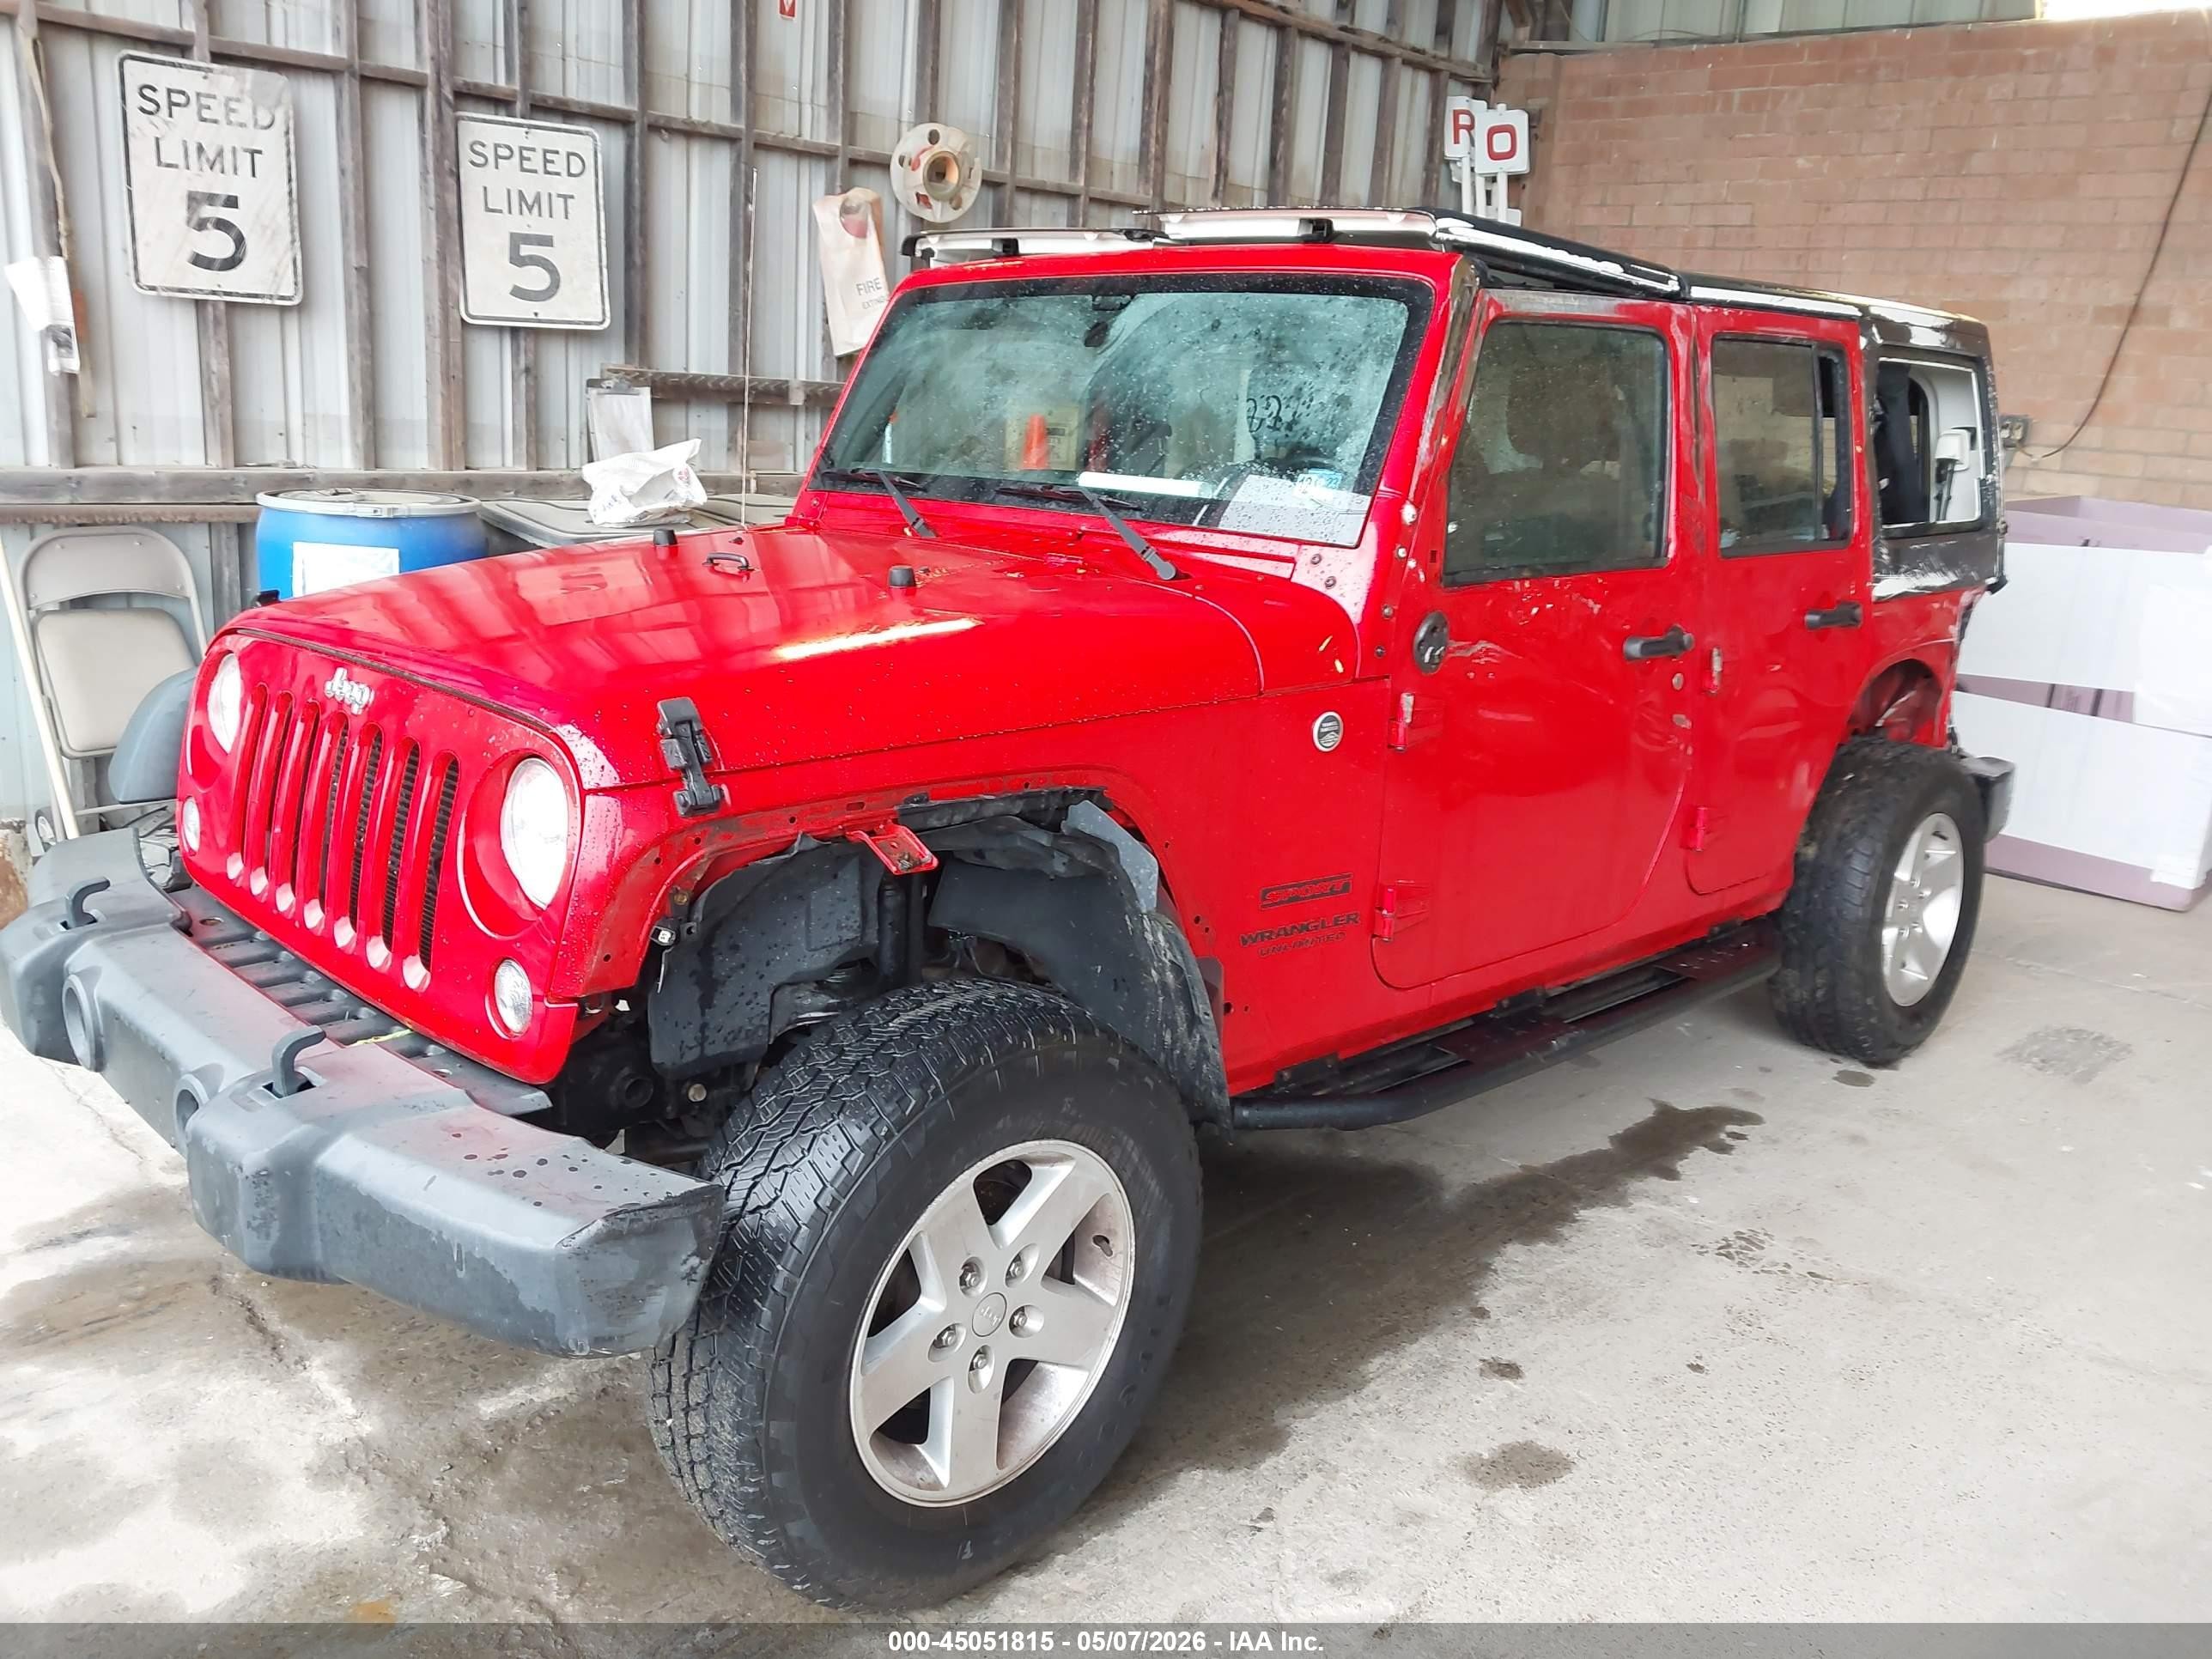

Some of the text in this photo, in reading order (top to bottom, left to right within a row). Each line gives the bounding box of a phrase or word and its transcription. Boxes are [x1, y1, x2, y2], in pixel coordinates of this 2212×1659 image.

[137, 83, 276, 130] SPEED
[155, 136, 263, 178] LIMIT
[468, 140, 586, 178] SPEED
[483, 185, 575, 220] LIMIT
[186, 190, 246, 272] 5
[509, 232, 561, 302] 5
[856, 277, 882, 295] FIRE
[324, 666, 375, 715] Jeep
[1240, 911, 1360, 947] WRANGLER
